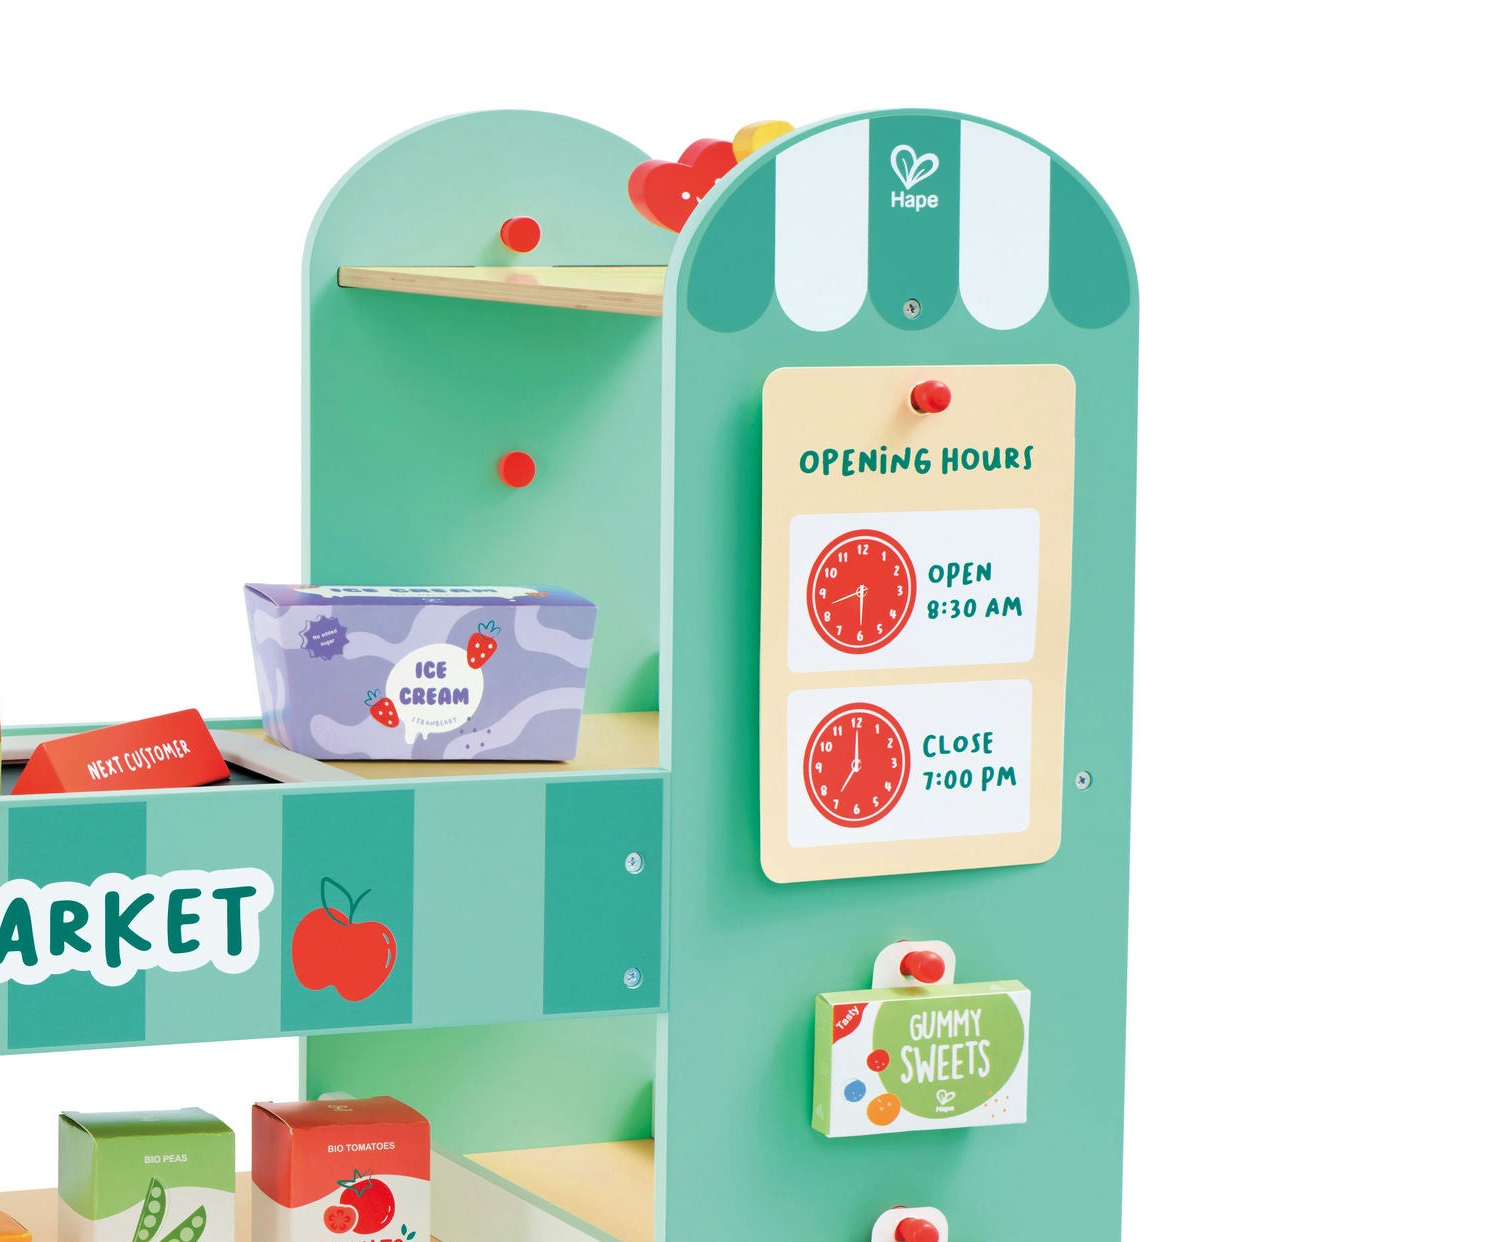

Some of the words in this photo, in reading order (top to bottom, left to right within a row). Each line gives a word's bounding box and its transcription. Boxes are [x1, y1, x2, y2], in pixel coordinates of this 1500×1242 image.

[890, 190, 938, 212] Hape
[942, 445, 1034, 475] HOURS
[857, 544, 869, 555] 12
[837, 552, 848, 562] 11
[881, 551, 886, 562] 1
[824, 567, 838, 578] 10
[893, 565, 900, 576] 2
[928, 562, 992, 588] OPEN
[819, 588, 826, 599] 9
[897, 585, 903, 596] 3
[927, 598, 977, 619] 8:30
[985, 596, 1023, 618] AM
[823, 611, 831, 622] 8
[889, 609, 896, 620] 4
[836, 625, 842, 636] 7
[876, 624, 883, 634] 5
[856, 630, 863, 641] 6
[415, 661, 447, 679] ICE
[399, 687, 469, 705] CREAM
[851, 717, 863, 728] 12
[833, 725, 843, 736] 11
[875, 724, 880, 734] 1
[820, 741, 833, 752] 10
[887, 737, 894, 748] 2
[922, 731, 993, 758] CLOSE
[87, 755, 124, 780] NEXT
[124, 739, 191, 772] CUSTOMER
[891, 757, 897, 768] 3
[815, 762, 822, 773] 9
[922, 768, 973, 791] 7:00
[981, 766, 1017, 792] PM
[820, 785, 827, 796] 8
[884, 781, 892, 792] 4
[833, 799, 839, 810] 7
[872, 796, 879, 807] 5
[853, 803, 860, 815] 6
[835, 1005, 860, 1030] Tasty
[909, 1008, 982, 1041] GUMMY
[900, 1039, 990, 1084] SWEETS
[327, 1144, 344, 1153] BIO
[346, 1141, 396, 1152] TOMATOES
[144, 1155, 161, 1164] BIO
[163, 1154, 188, 1163] PEAS
